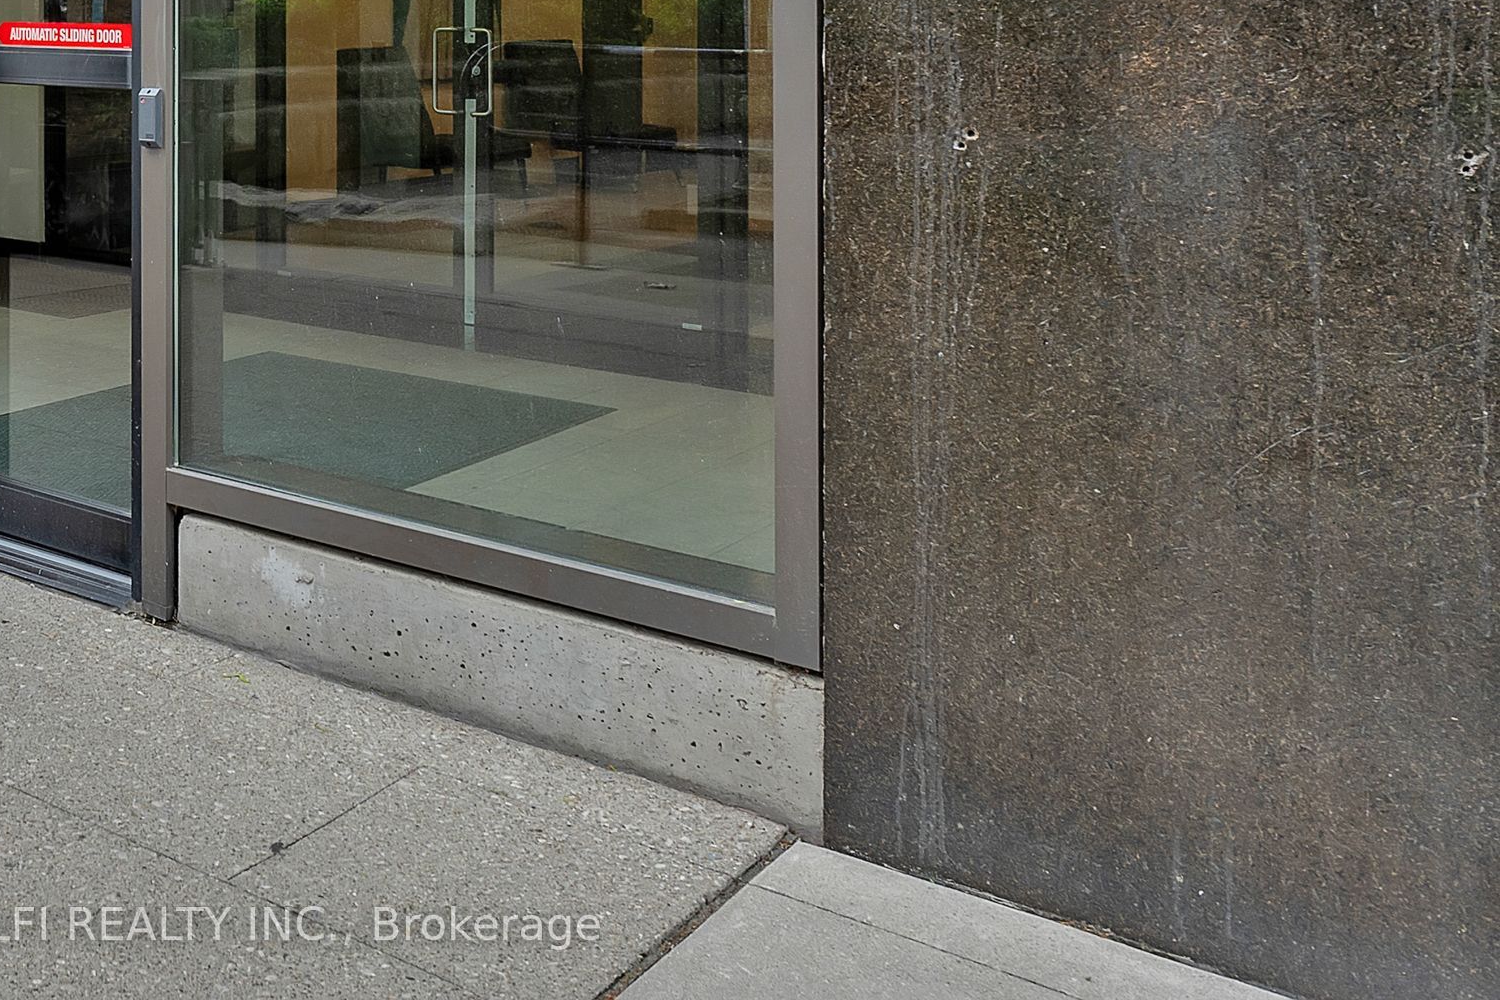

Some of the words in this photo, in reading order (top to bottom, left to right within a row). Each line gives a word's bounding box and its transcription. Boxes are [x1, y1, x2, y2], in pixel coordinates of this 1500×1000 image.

[10, 27, 58, 41] AUTOMATIC
[60, 28, 94, 42] SLIDING
[96, 29, 122, 43] DOOR
